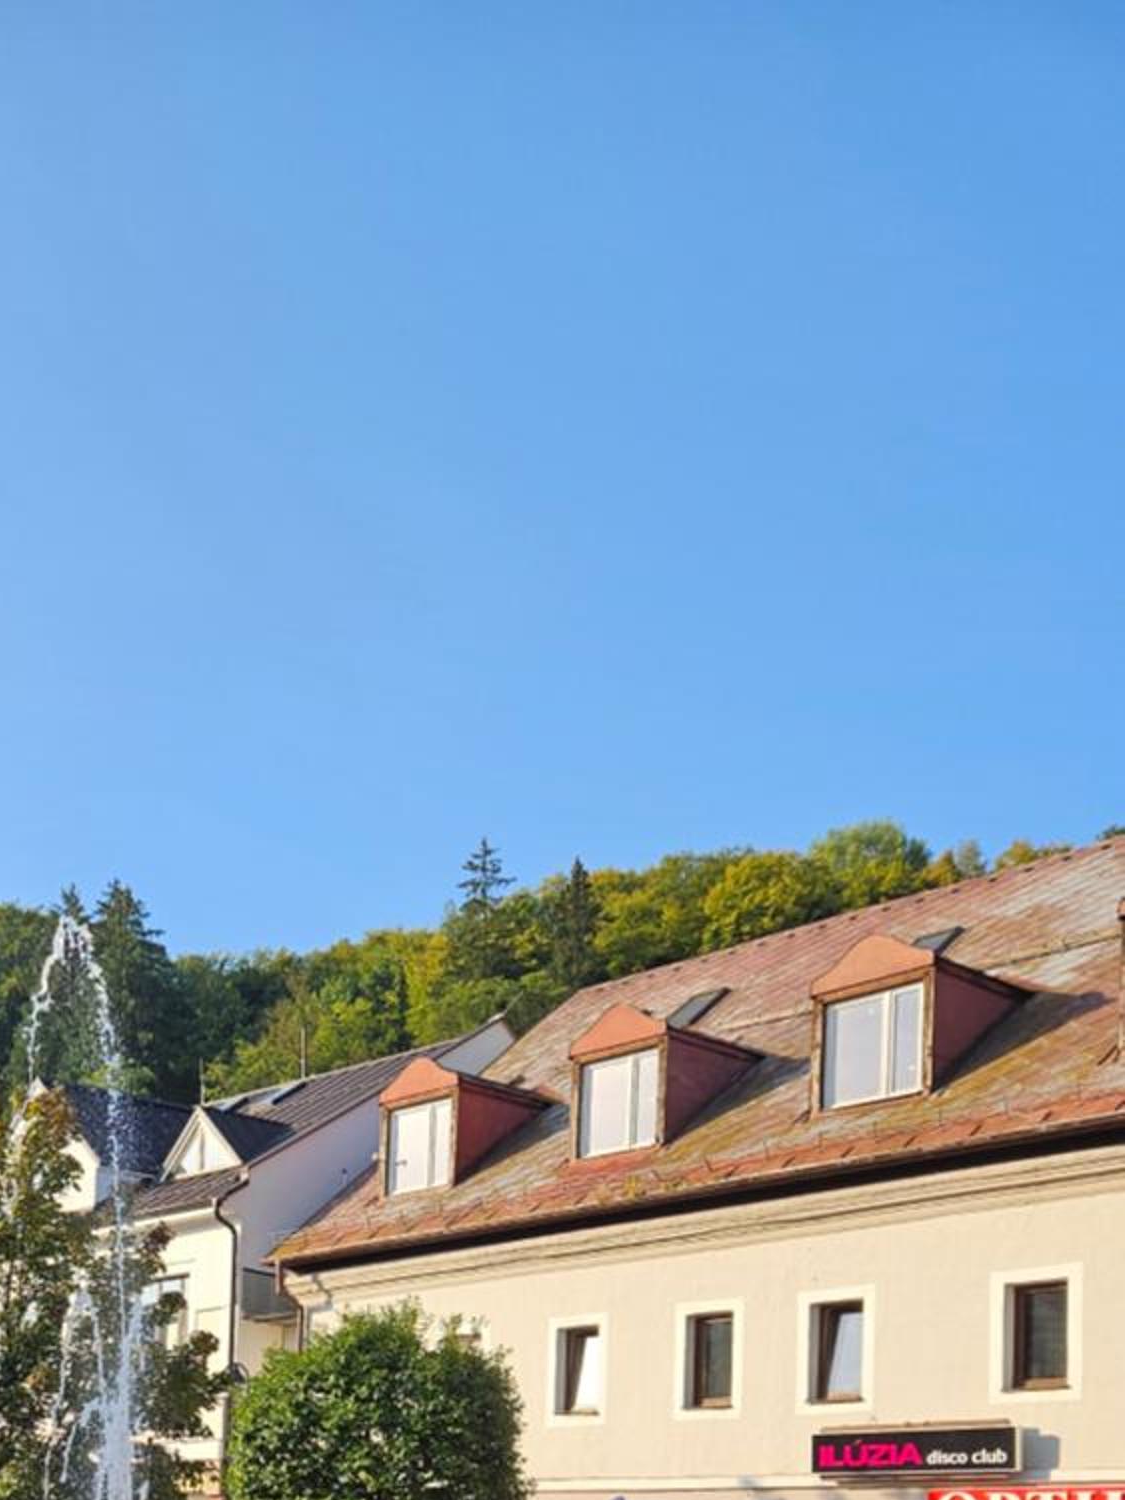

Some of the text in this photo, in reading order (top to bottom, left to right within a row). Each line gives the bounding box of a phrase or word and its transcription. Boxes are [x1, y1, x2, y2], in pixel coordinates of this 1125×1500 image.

[818, 1439, 1008, 1468] ILÚZIA disco club
